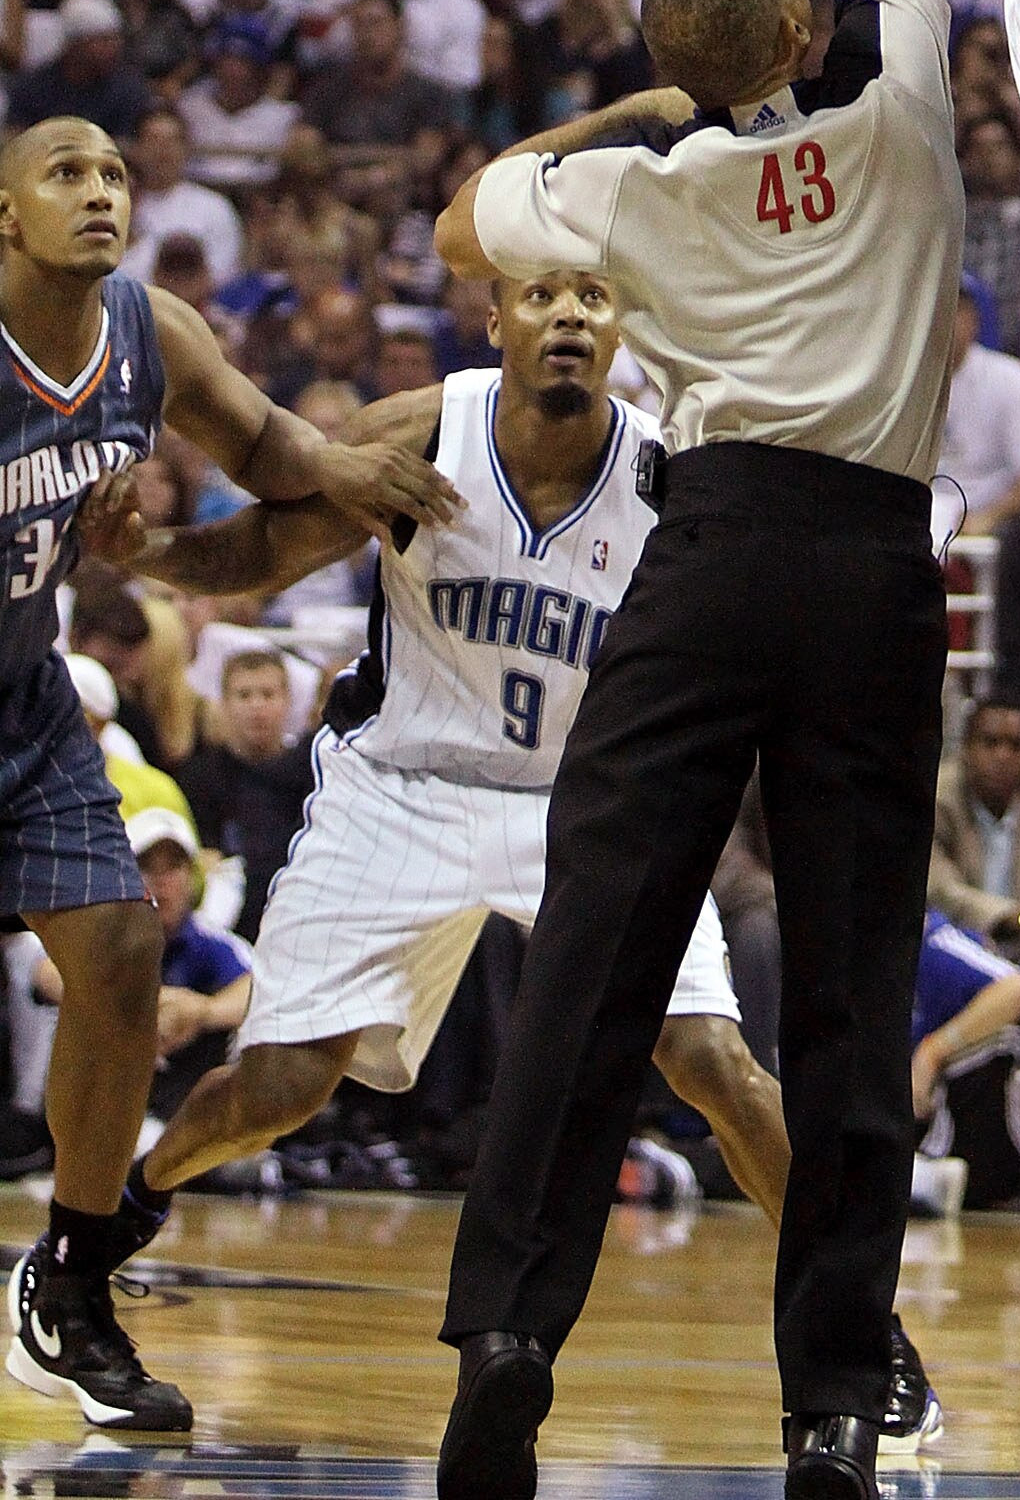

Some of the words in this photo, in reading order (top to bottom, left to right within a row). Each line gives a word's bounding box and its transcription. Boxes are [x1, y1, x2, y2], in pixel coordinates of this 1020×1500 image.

[750, 116, 785, 133] adidas
[757, 141, 836, 234] 43
[10, 515, 72, 598] 3
[501, 667, 546, 750] 9
